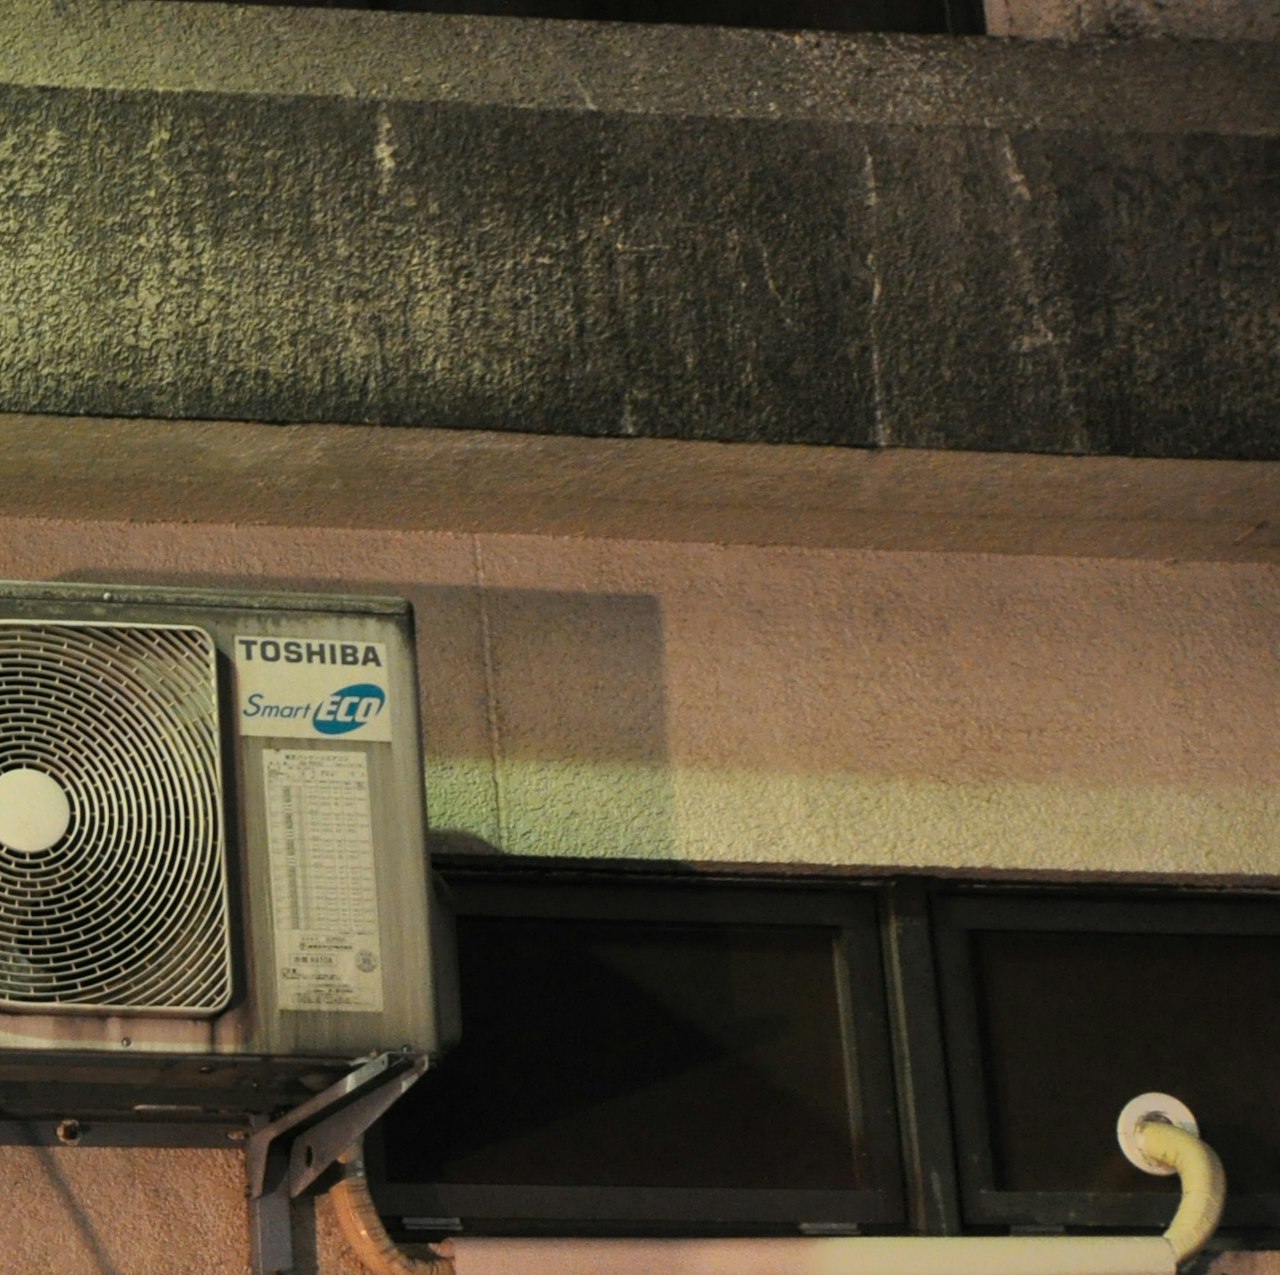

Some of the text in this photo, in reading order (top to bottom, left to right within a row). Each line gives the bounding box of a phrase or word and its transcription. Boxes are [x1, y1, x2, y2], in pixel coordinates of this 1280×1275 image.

[239, 640, 382, 667] TOSHIBA
[243, 693, 381, 724] Smart ECO
